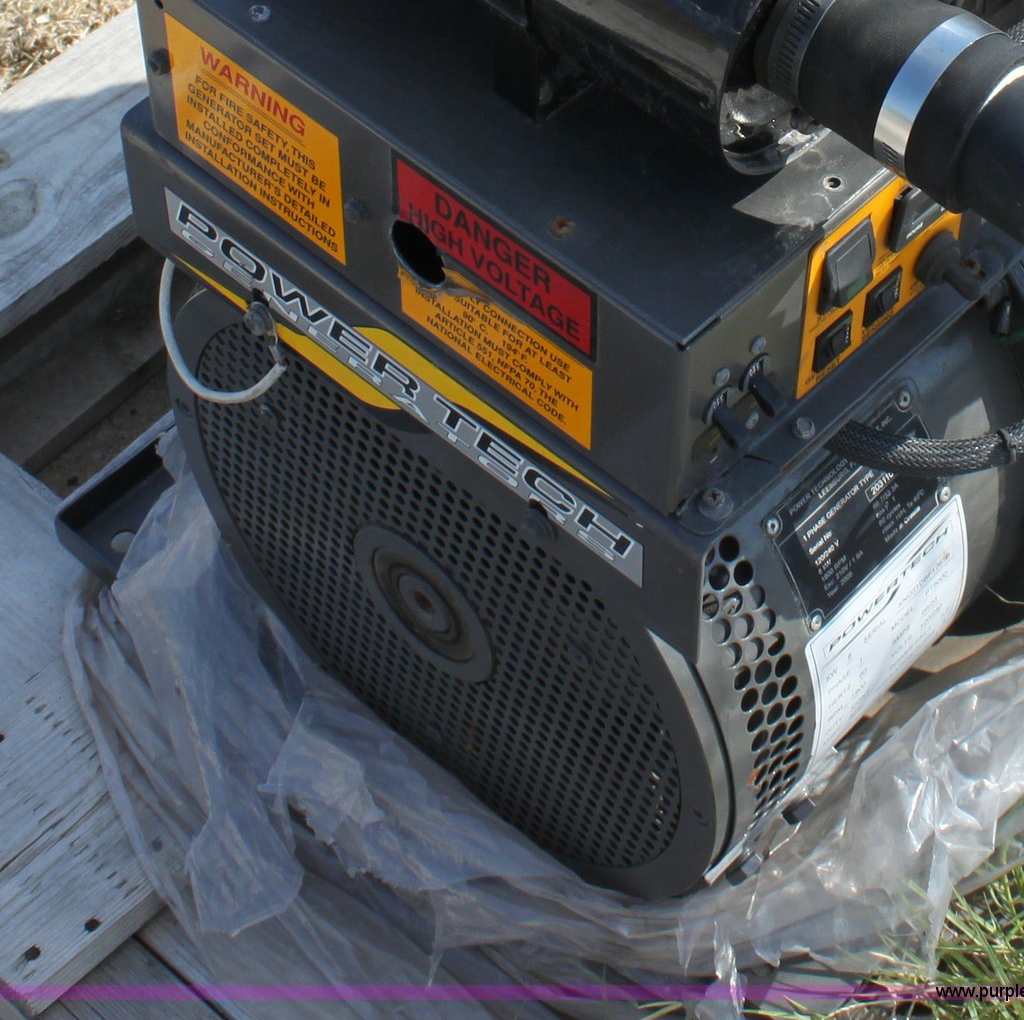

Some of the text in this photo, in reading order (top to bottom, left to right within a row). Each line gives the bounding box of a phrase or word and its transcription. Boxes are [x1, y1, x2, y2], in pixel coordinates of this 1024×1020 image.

[188, 84, 327, 192] GENERATOR SET MUST BE
[196, 75, 316, 170] FOR FIRE SAFETY, THIS
[200, 46, 306, 136] WARNING
[185, 132, 338, 253] INSTALLATION INSTRUCTIONS
[186, 120, 336, 238] MANUFACTURER'S DETAILED
[187, 95, 330, 208] INSTALLED COMPLETELY IN
[204, 122, 315, 209] CONFORMANCE WITH
[408, 202, 580, 342] HIGH VOLTAGE
[434, 193, 550, 293] DANGER
[415, 289, 579, 412] INSTALLATION MUST COMPLY WITH
[427, 317, 472, 354] NATIONAL
[475, 353, 534, 401] ELECTRICAL
[435, 313, 475, 346] ARTICLE
[497, 355, 521, 380] NFPA
[539, 389, 558, 407] THE
[454, 296, 499, 332] SUITABLE
[503, 330, 523, 348] FOR
[525, 346, 536, 359] AT
[539, 357, 572, 383] LEAST
[484, 302, 571, 371] CONNECTION USE
[789, 491, 811, 516] POWER
[806, 515, 826, 538] PHASE
[826, 483, 859, 520] GENERATOR
[858, 469, 874, 488] TYPE
[808, 536, 824, 556] Serial
[814, 543, 835, 567] 120/240
[834, 539, 840, 548] V
[828, 525, 947, 653] POWERTECH
